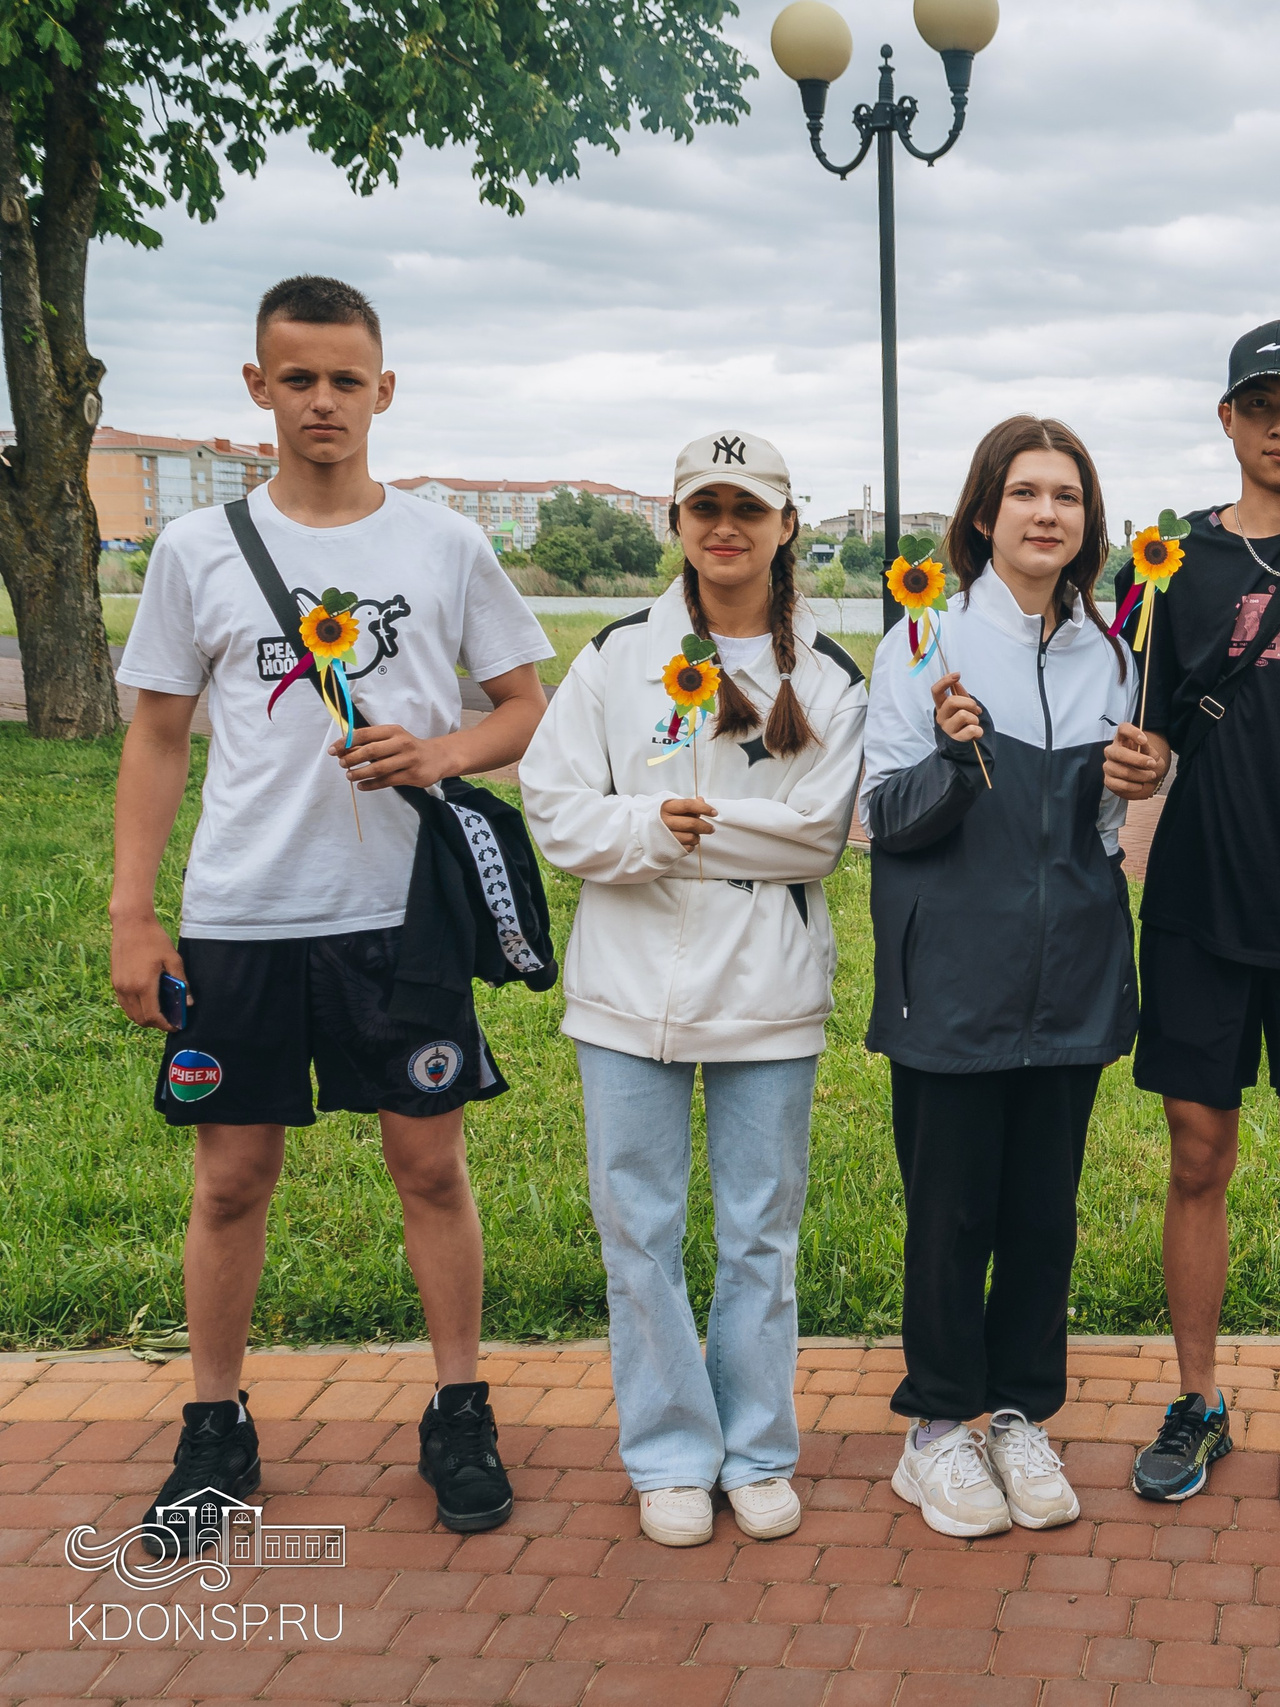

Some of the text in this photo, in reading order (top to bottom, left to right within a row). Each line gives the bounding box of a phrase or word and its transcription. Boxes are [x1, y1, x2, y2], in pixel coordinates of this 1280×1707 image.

[712, 436, 746, 465] NY
[262, 642, 297, 659] PEA
[170, 1066, 218, 1082] РУБЕЖ
